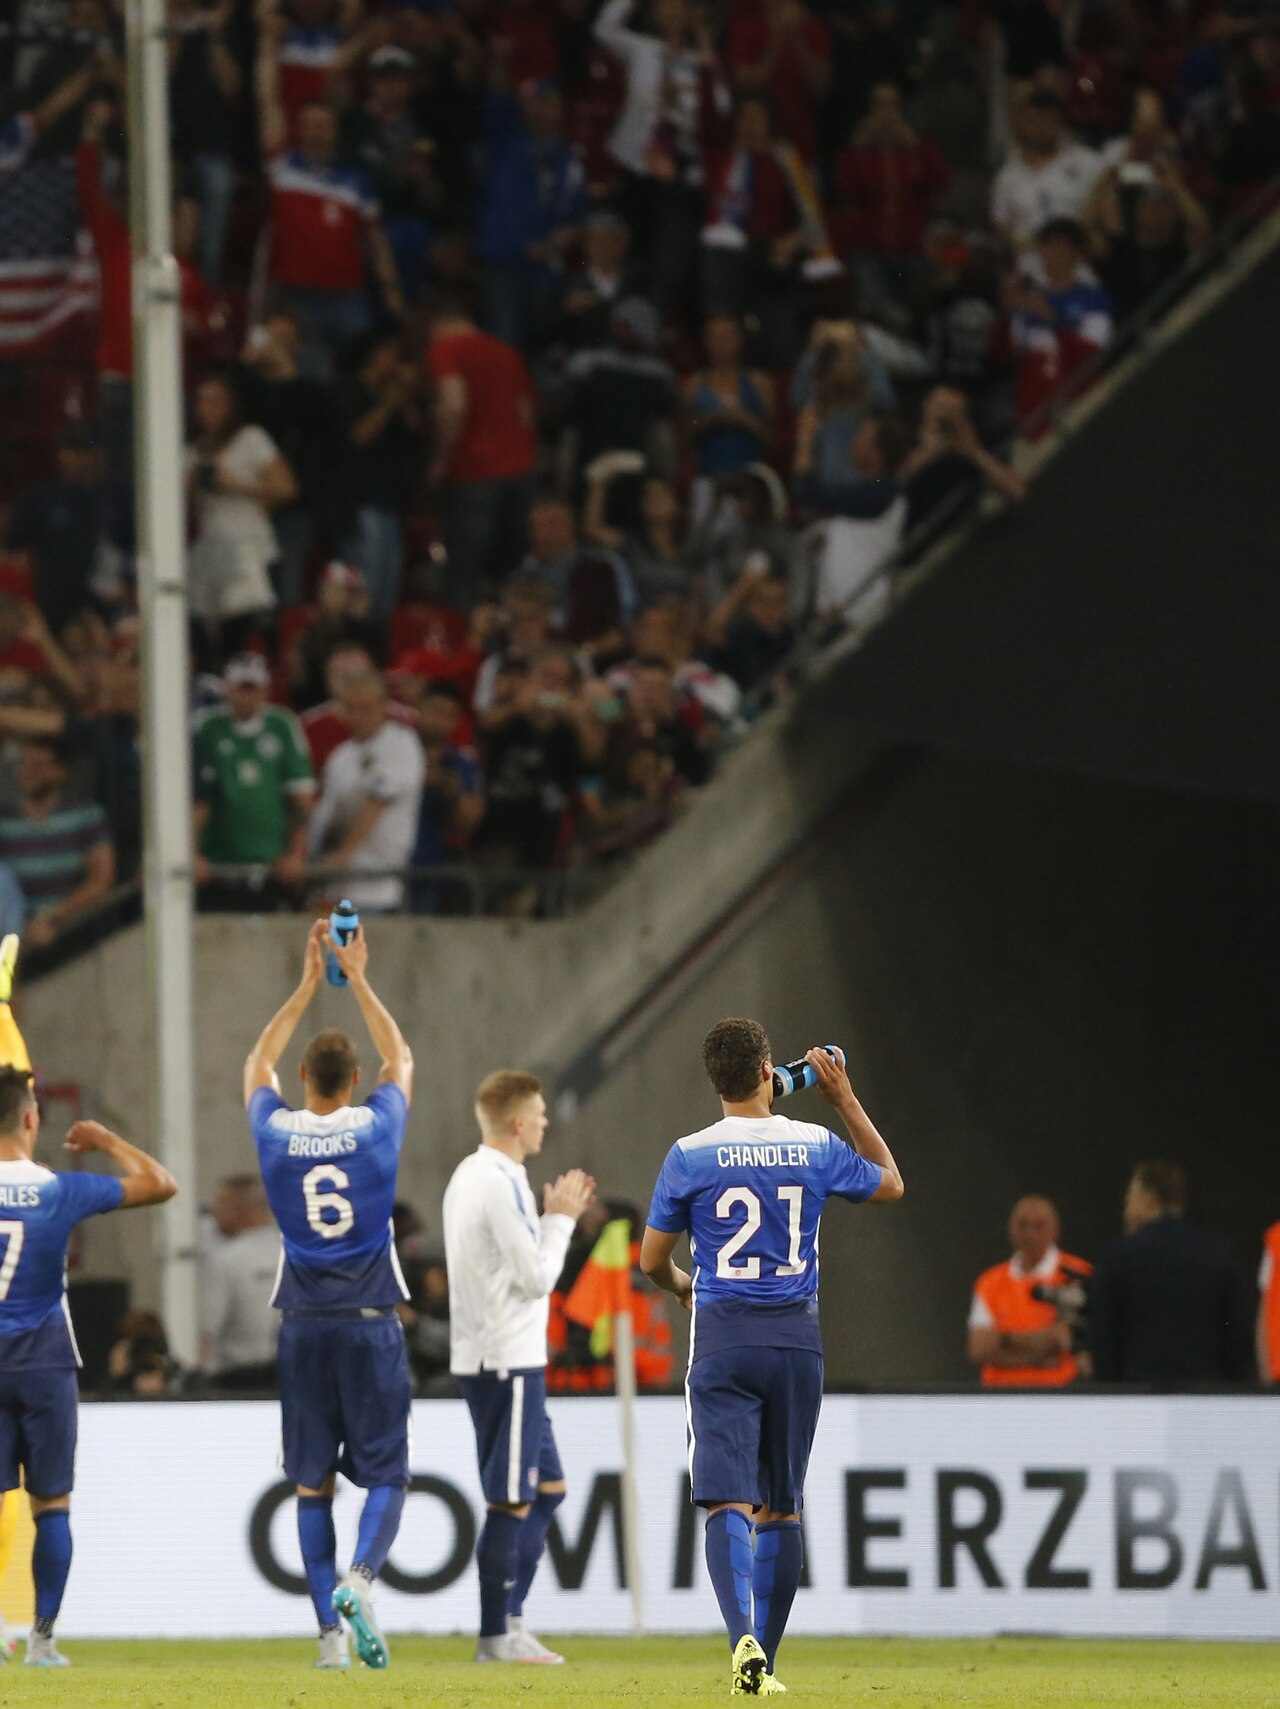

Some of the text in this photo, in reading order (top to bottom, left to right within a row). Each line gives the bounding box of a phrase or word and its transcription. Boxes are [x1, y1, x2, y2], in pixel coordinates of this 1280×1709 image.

[287, 1131, 358, 1157] BROOKS
[715, 1144, 809, 1168] CHANDLER
[303, 1164, 354, 1239] 6
[715, 1186, 808, 1280] 21
